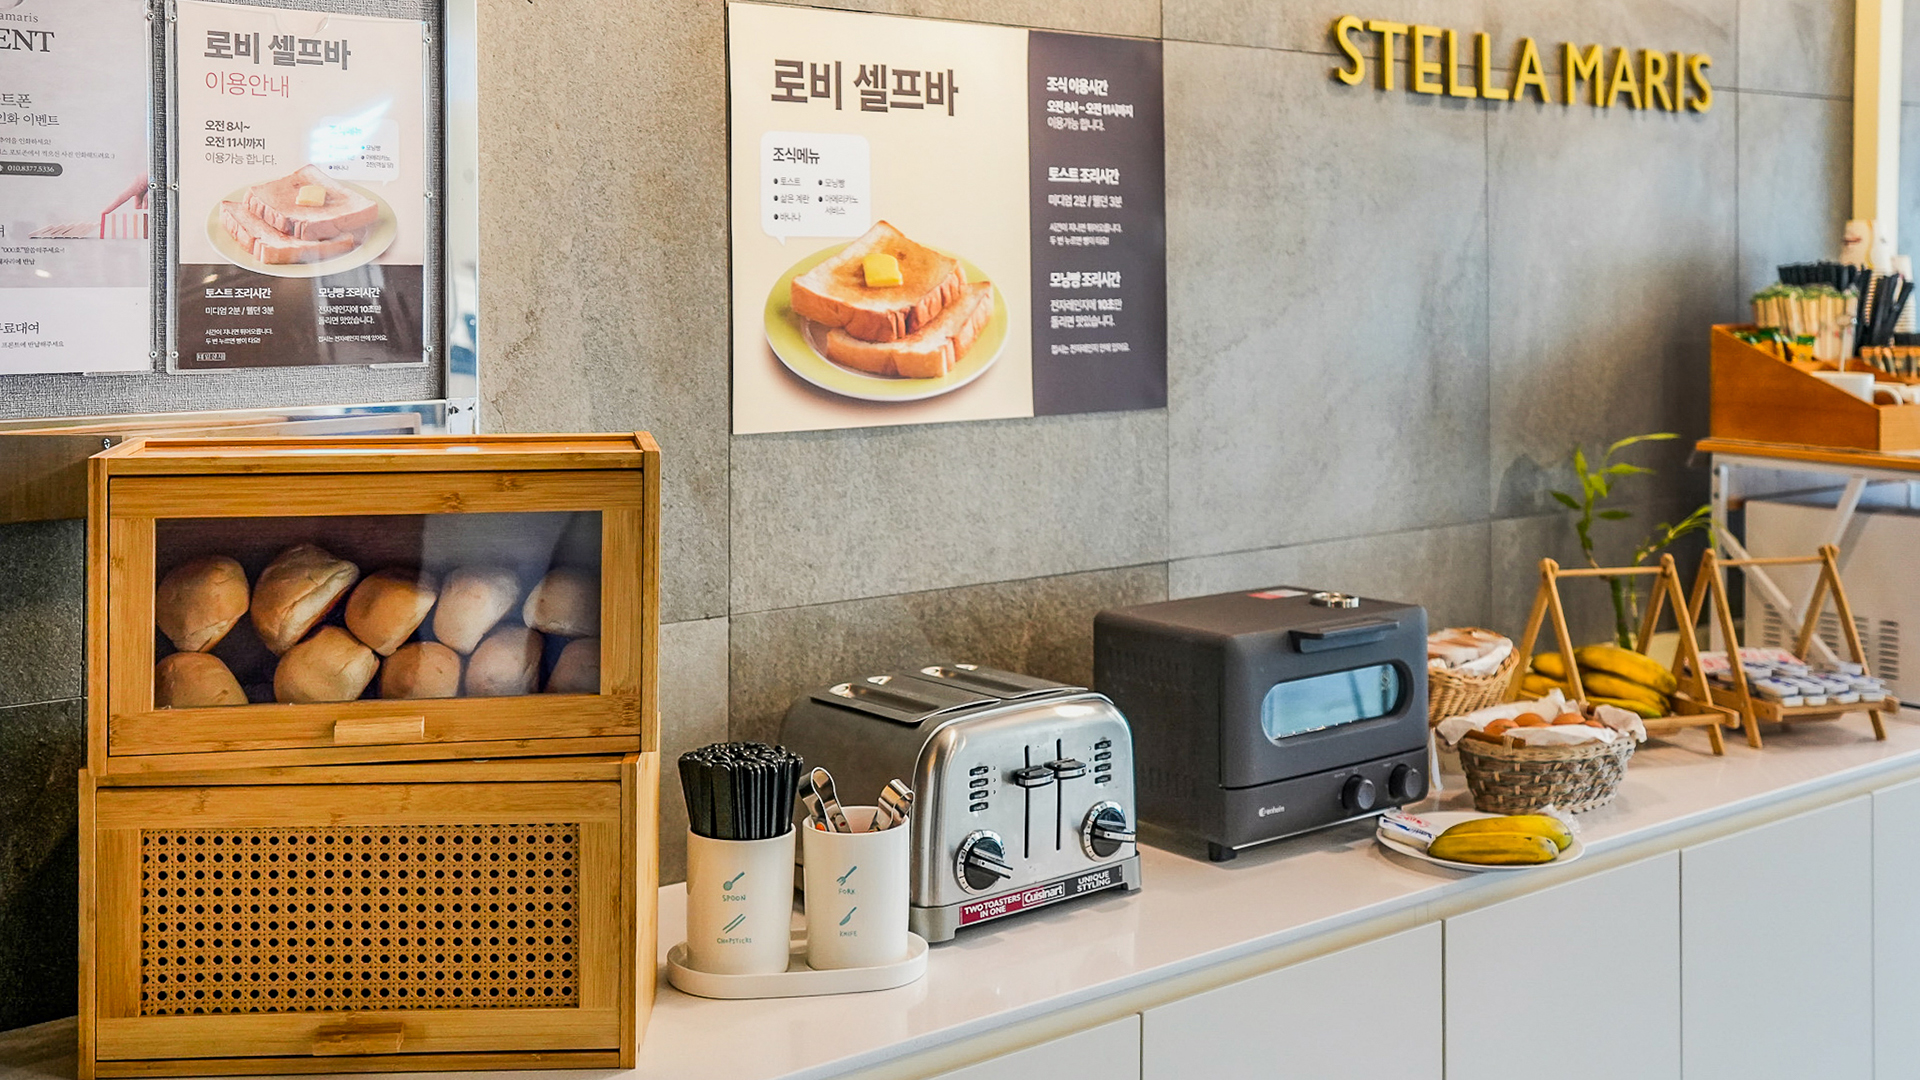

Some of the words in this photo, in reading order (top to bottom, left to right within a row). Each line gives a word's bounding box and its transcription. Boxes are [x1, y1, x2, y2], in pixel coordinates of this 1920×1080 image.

[204, 30, 260, 65] 로비
[268, 35, 352, 70] 셀프바
[1333, 14, 1551, 103] STELLA
[1562, 41, 1713, 114] MARIS
[205, 71, 290, 98] 이용안내
[771, 59, 842, 110] 로비
[853, 63, 959, 117] 셀프바
[1046, 76, 1068, 94] 조식
[1068, 78, 1109, 96] 이용시간
[0, 93, 32, 109] 트폰
[1047, 100, 1064, 113] 오전
[1064, 101, 1079, 115] 8시
[1085, 102, 1103, 116] 오전
[1103, 103, 1134, 118] 11시까지
[23, 113, 60, 127] 이벤트
[205, 120, 225, 132] 오전
[1047, 116, 1079, 130] 이용가능
[1080, 118, 1105, 131] 합니다.
[205, 136, 225, 148] 오전
[226, 137, 266, 150] 11시까지
[205, 151, 244, 164] 이용가능
[246, 153, 277, 165] 합니다.
[772, 147, 820, 165] 조식메뉴
[780, 177, 801, 186] 토스트
[1048, 166, 1079, 182] 토스트
[1080, 167, 1120, 185] 조리시간
[824, 178, 845, 189] 모닝빵
[824, 194, 859, 204] 아메리카노
[1048, 194, 1073, 207] 미디엄
[1073, 195, 1087, 207] 2분
[1092, 195, 1109, 208] 웰던
[1109, 195, 1123, 208] 3분
[780, 212, 801, 222] 바나나
[824, 206, 846, 216] 서비스
[1049, 271, 1082, 288] 모닝빵
[1081, 271, 1122, 288] 조리시간
[205, 288, 234, 299] 토스트
[234, 287, 272, 299] 조리시간
[318, 287, 345, 299] 모닝빵
[345, 287, 381, 299] 조리시간
[205, 306, 227, 315] 미디엄
[228, 306, 240, 315] 2분
[246, 306, 261, 315] 웰던
[261, 306, 274, 315] 3분
[318, 305, 358, 314] 전자레인지에
[359, 305, 381, 314] 10초만
[1050, 298, 1097, 312] 전자레인지에
[318, 316, 339, 325] 돌리면
[340, 316, 375, 325] 맛있습니다.
[1078, 871, 1110, 884] UNIQUE
[1077, 877, 1111, 893] STYLING
[722, 894, 746, 902] SPOON
[1024, 884, 1063, 904] Cuisinart
[964, 904, 984, 915] TWO
[982, 894, 1021, 912] TOASTERS
[980, 908, 990, 918] IN
[989, 906, 1006, 916] ONE
